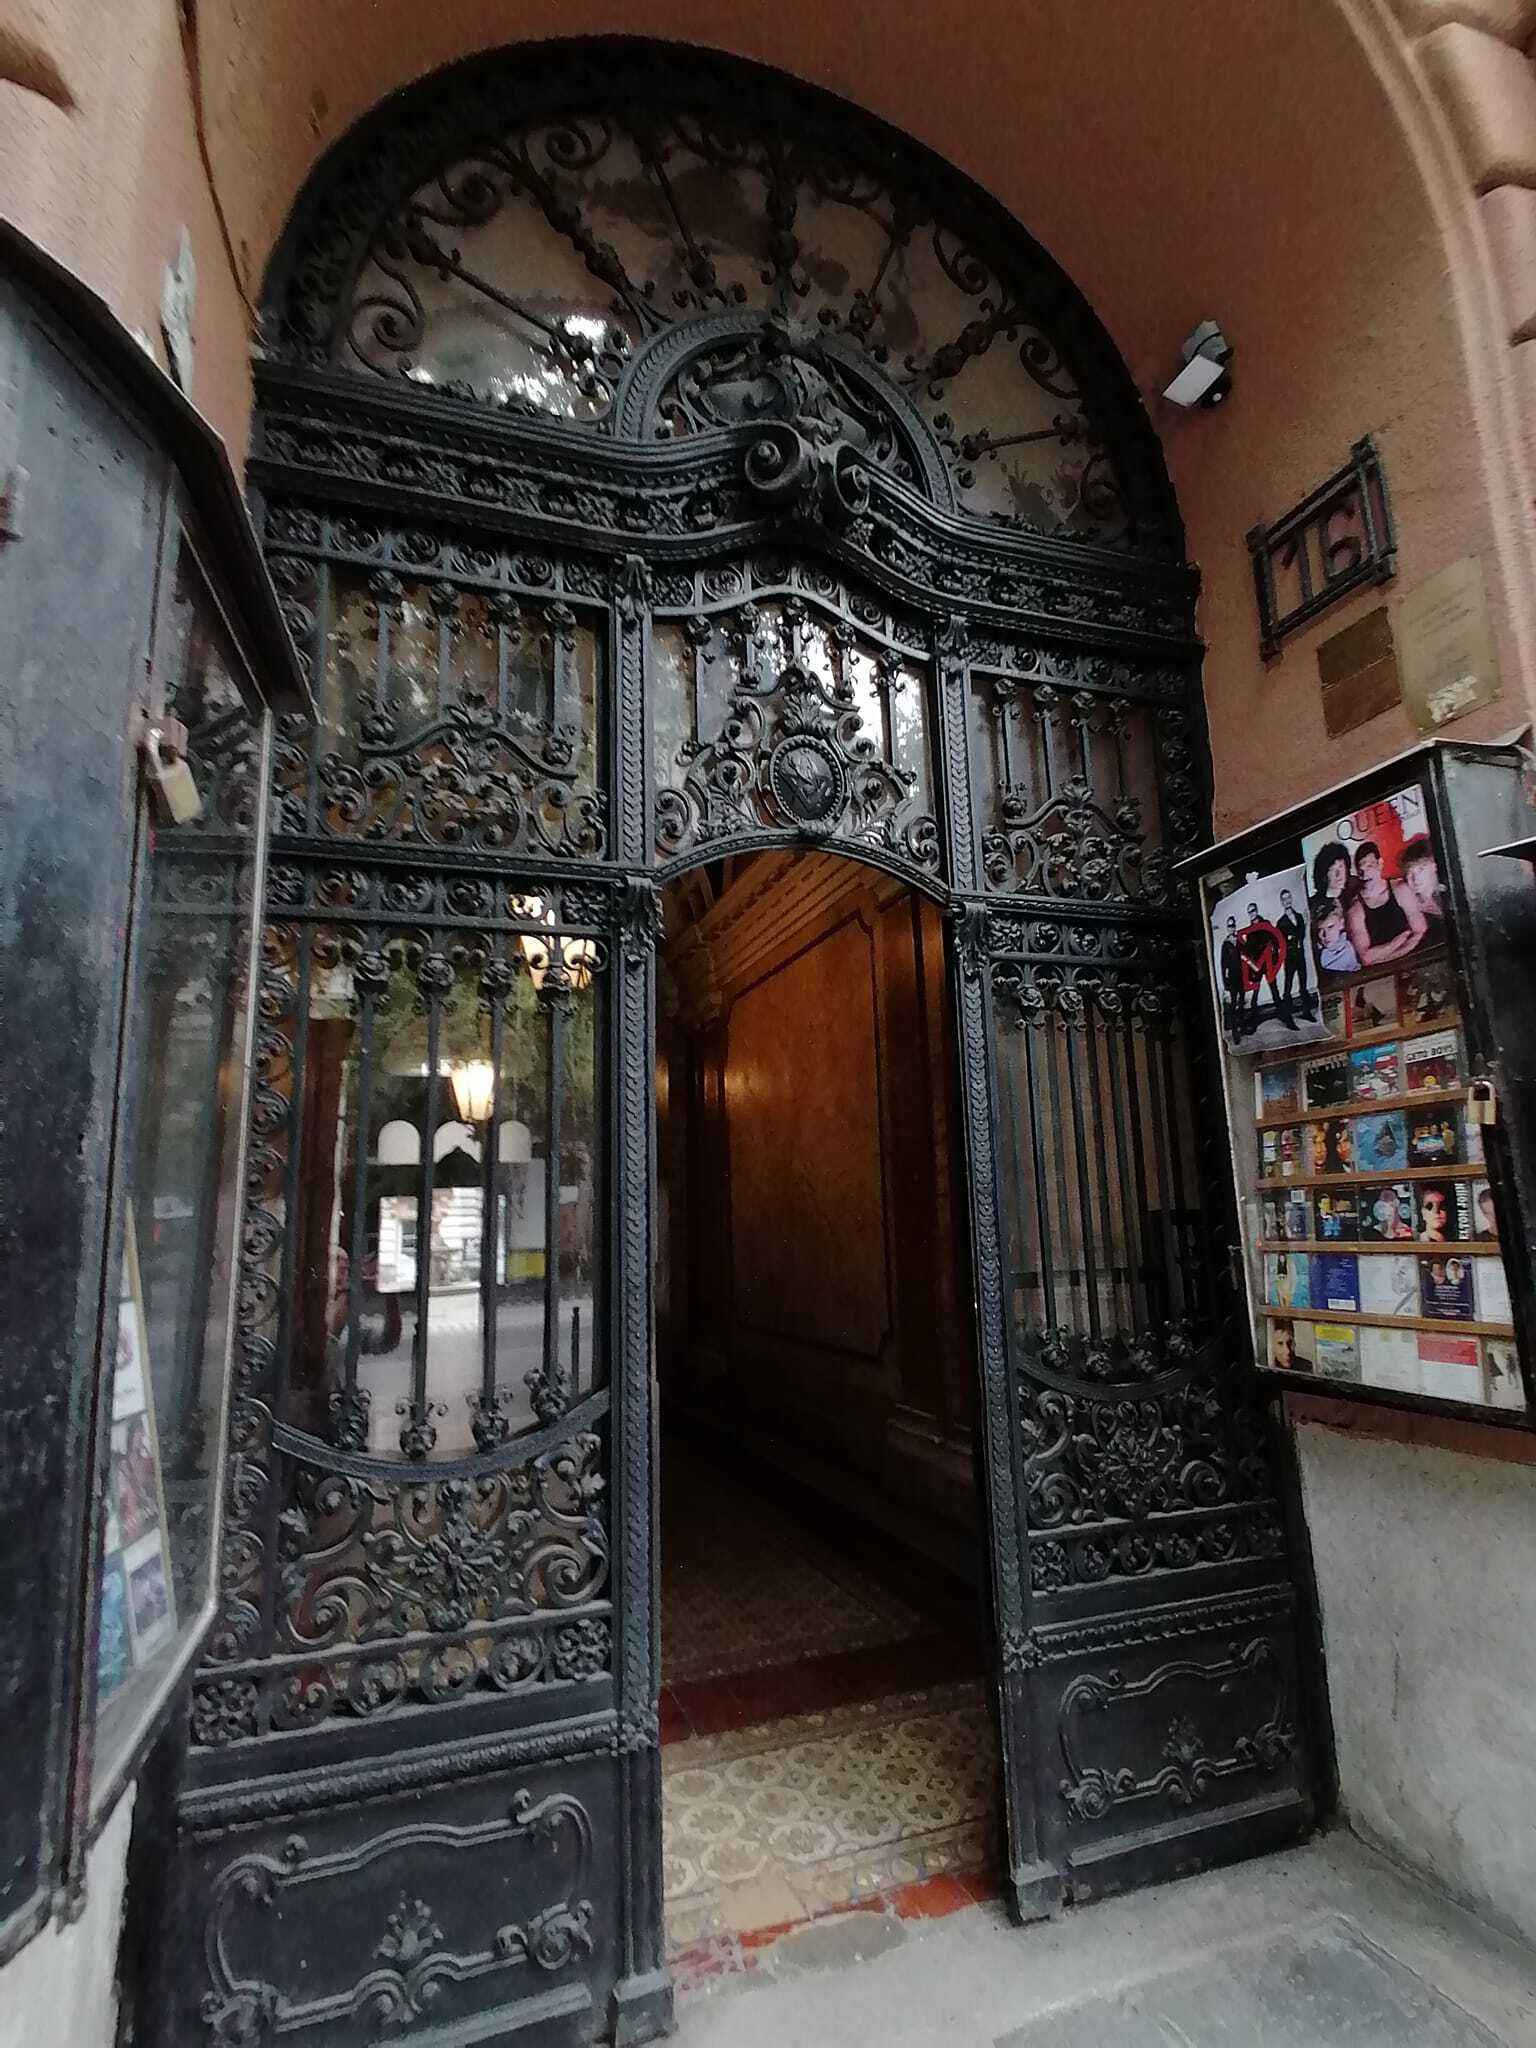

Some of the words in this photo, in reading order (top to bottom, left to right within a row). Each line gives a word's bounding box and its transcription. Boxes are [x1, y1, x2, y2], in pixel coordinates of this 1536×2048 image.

[1280, 496, 1361, 608] 16
[1337, 790, 1420, 841] QUEEN
[1454, 1183, 1468, 1206] JOHN
[1457, 1209, 1471, 1240] ELTON
